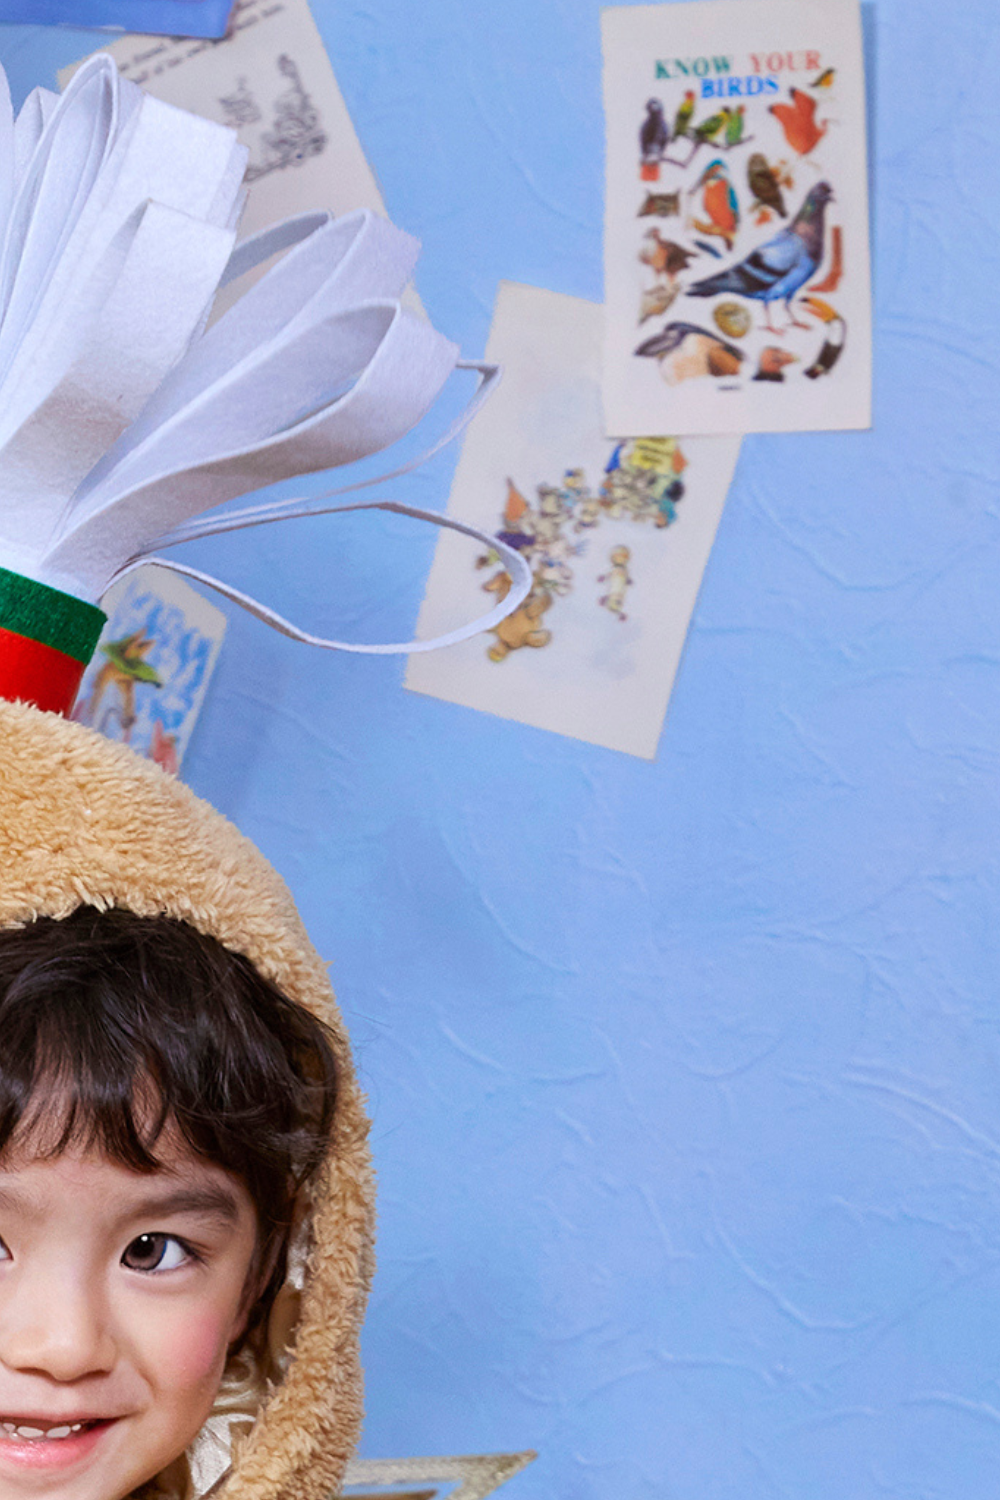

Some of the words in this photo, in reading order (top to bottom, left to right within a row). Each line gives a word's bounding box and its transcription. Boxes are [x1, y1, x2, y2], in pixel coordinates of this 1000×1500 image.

[655, 55, 733, 79] KNOW
[749, 50, 821, 73] YOUR
[701, 74, 779, 98] BIRDS
